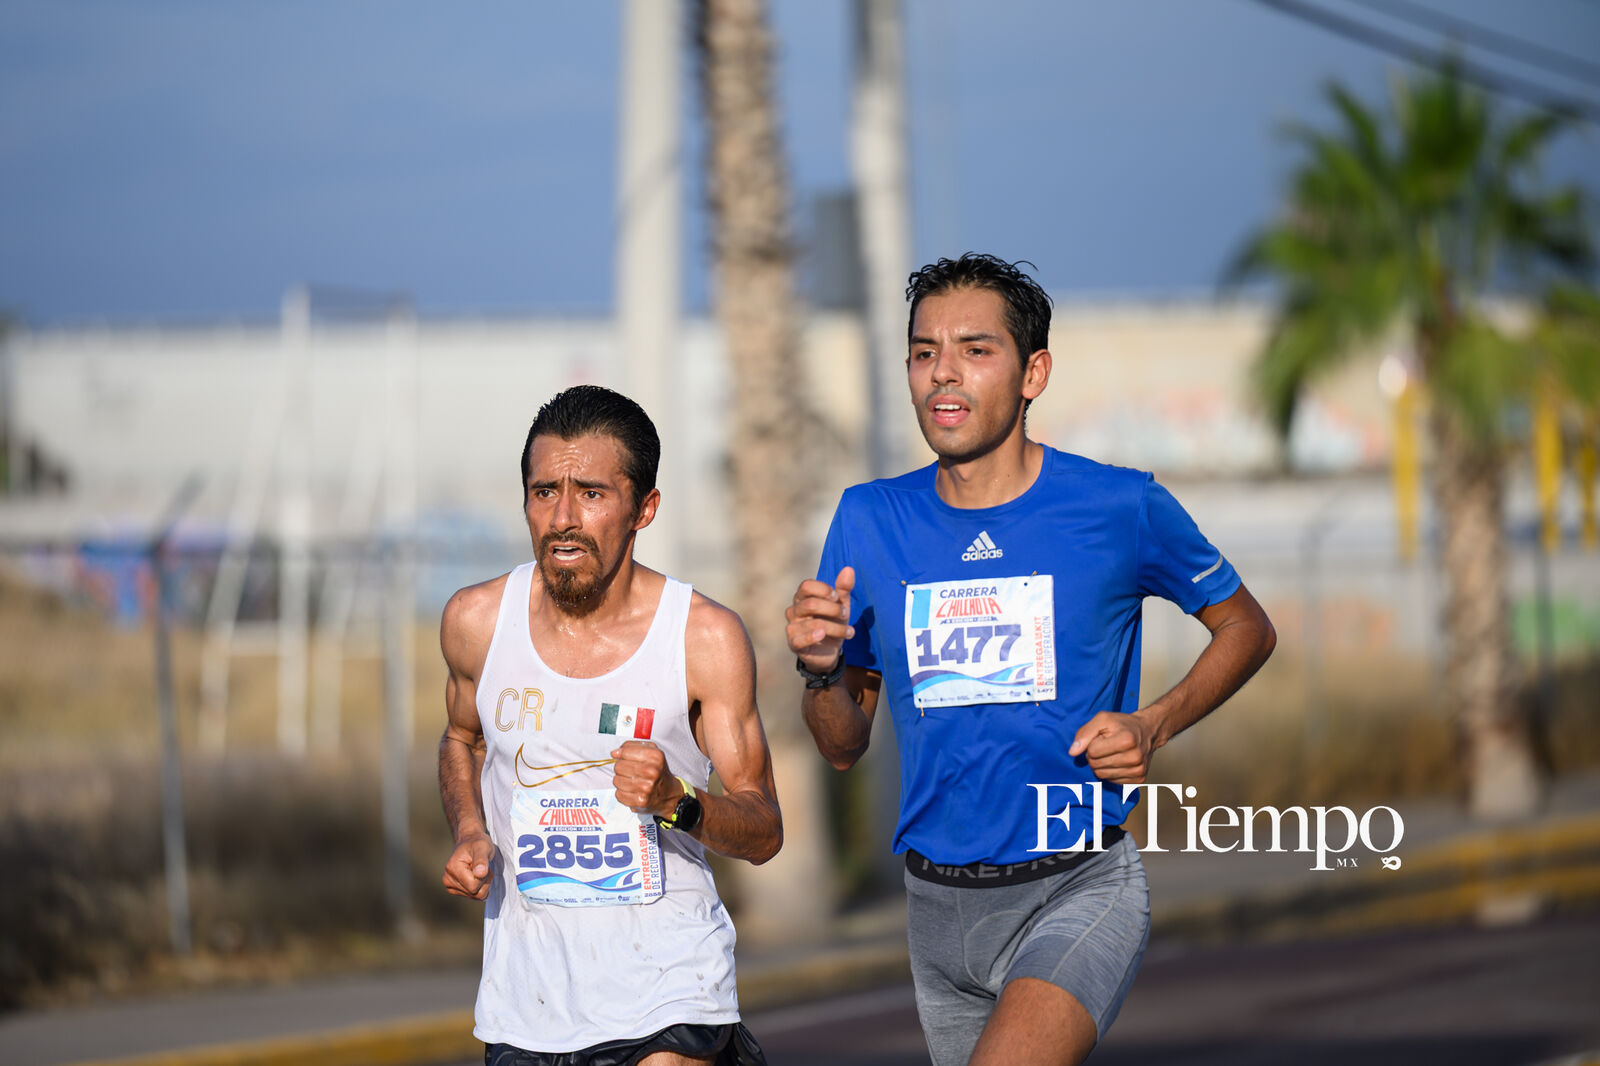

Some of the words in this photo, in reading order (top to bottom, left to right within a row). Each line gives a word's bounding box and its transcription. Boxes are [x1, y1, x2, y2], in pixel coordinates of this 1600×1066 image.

[961, 548, 1004, 562] adidas
[940, 586, 998, 599] CARRERA
[935, 597, 1003, 618] CHILCHOTA
[1033, 616, 1042, 631] KIT
[915, 624, 1022, 667] 1477
[1034, 641, 1045, 686] ENTREGA
[494, 687, 545, 732] CR
[540, 797, 600, 808] CARRERA
[538, 808, 607, 826] CHILCHOTA
[638, 824, 648, 839] KIT
[517, 832, 634, 870] 2855
[640, 847, 652, 890] ENTREGA
[651, 880, 661, 890] DE
